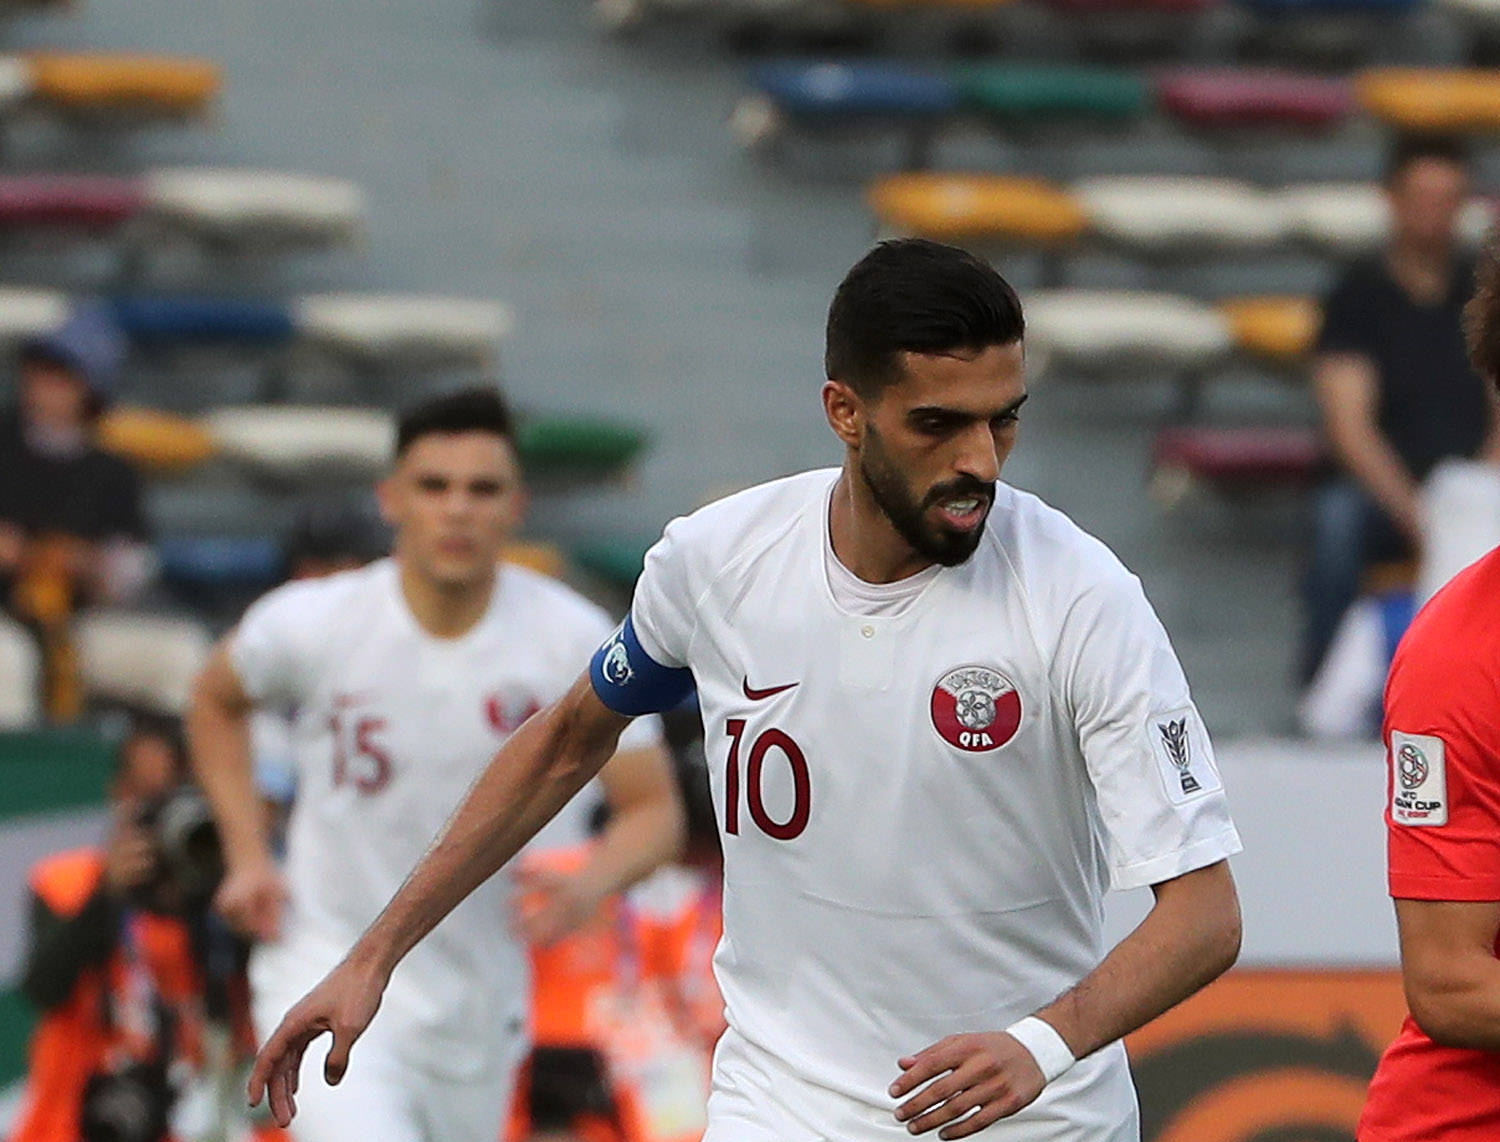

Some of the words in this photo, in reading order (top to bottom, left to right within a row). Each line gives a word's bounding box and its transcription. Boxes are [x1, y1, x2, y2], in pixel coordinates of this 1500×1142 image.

[326, 713, 394, 798] 15
[959, 731, 993, 747] QFA
[724, 718, 812, 841] 10
[1416, 801, 1441, 810] CUP
